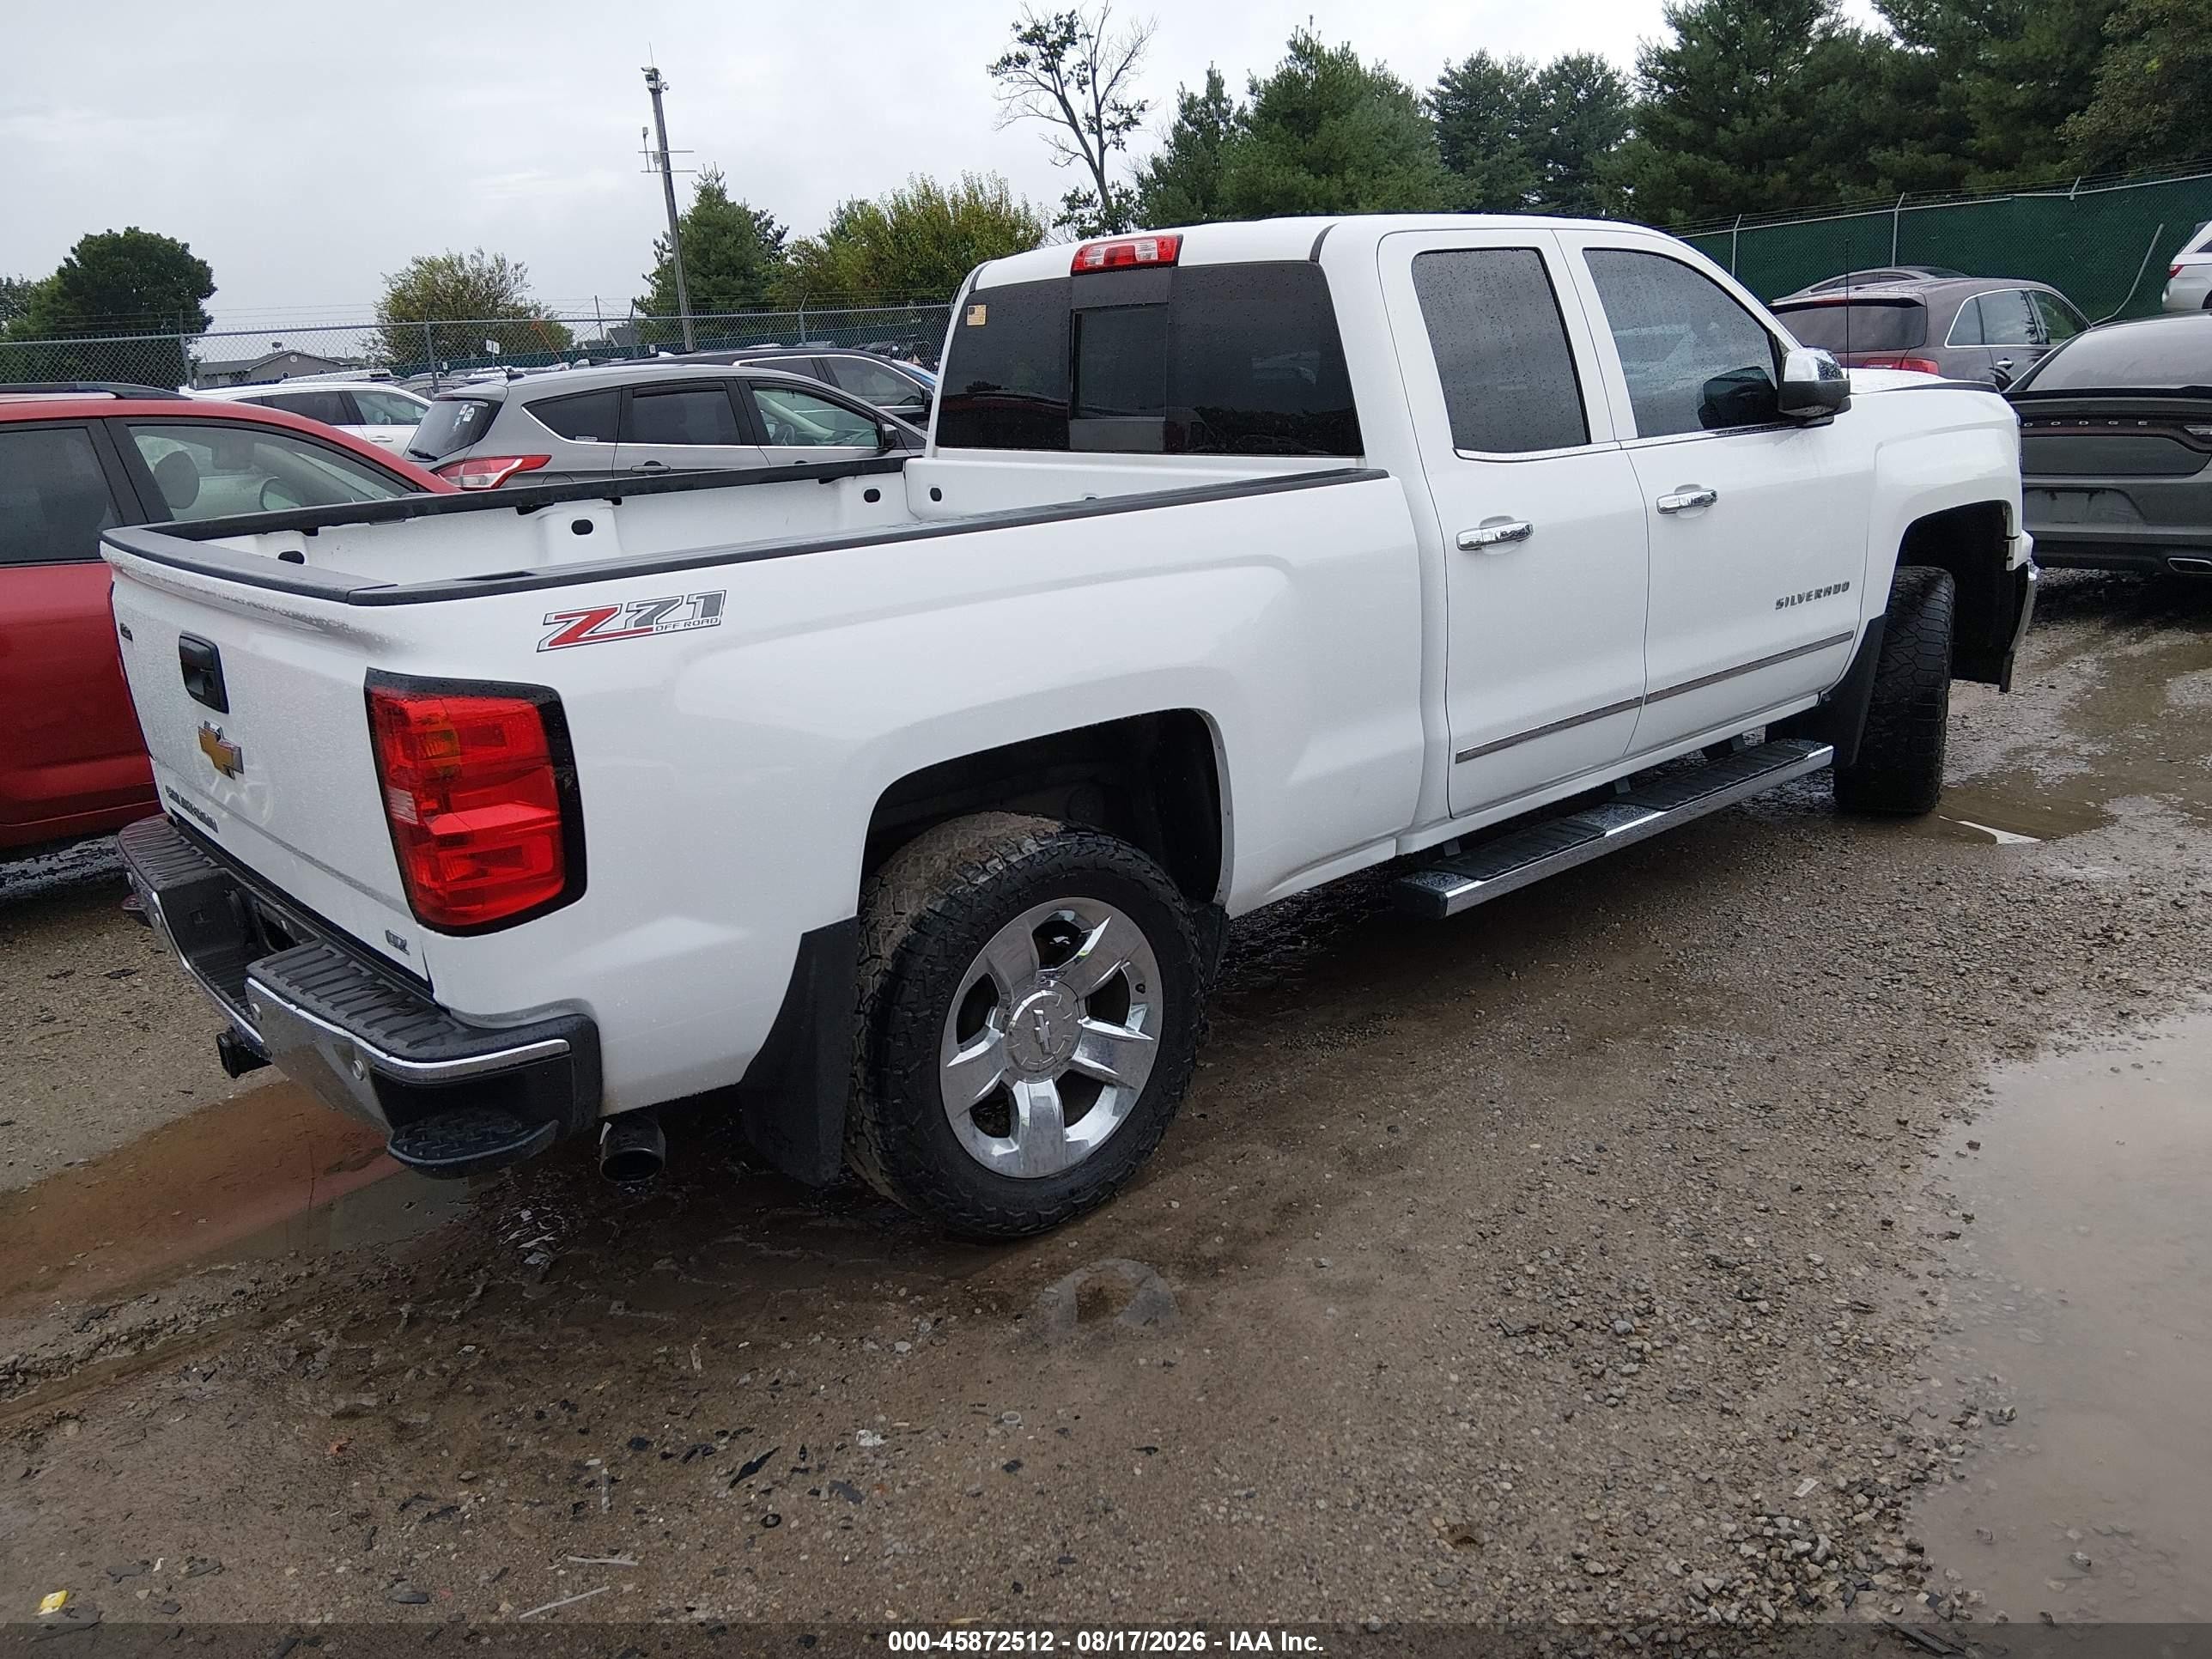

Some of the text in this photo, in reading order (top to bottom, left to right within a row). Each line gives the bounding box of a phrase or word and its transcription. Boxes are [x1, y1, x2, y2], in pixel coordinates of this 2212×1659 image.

[1775, 581, 1850, 611] SILVERADO
[536, 590, 727, 653] Z71
[655, 617, 719, 632] OFF ROAD
